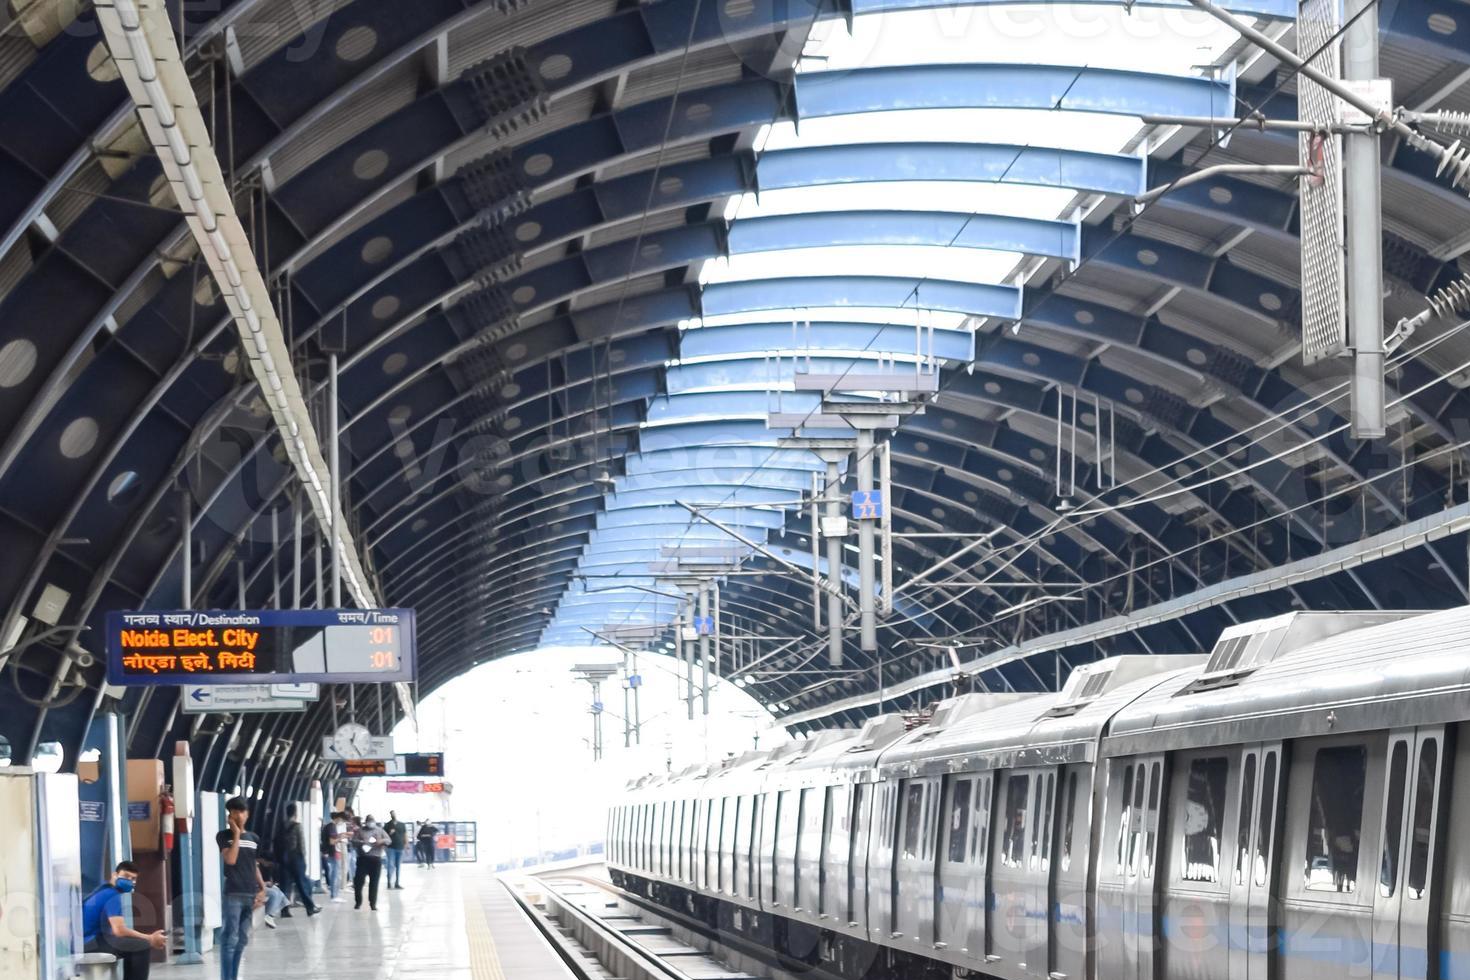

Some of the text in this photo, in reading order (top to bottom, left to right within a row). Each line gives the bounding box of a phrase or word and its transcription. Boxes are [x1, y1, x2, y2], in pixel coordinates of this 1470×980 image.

[121, 628, 259, 650] Noida Elect. City
